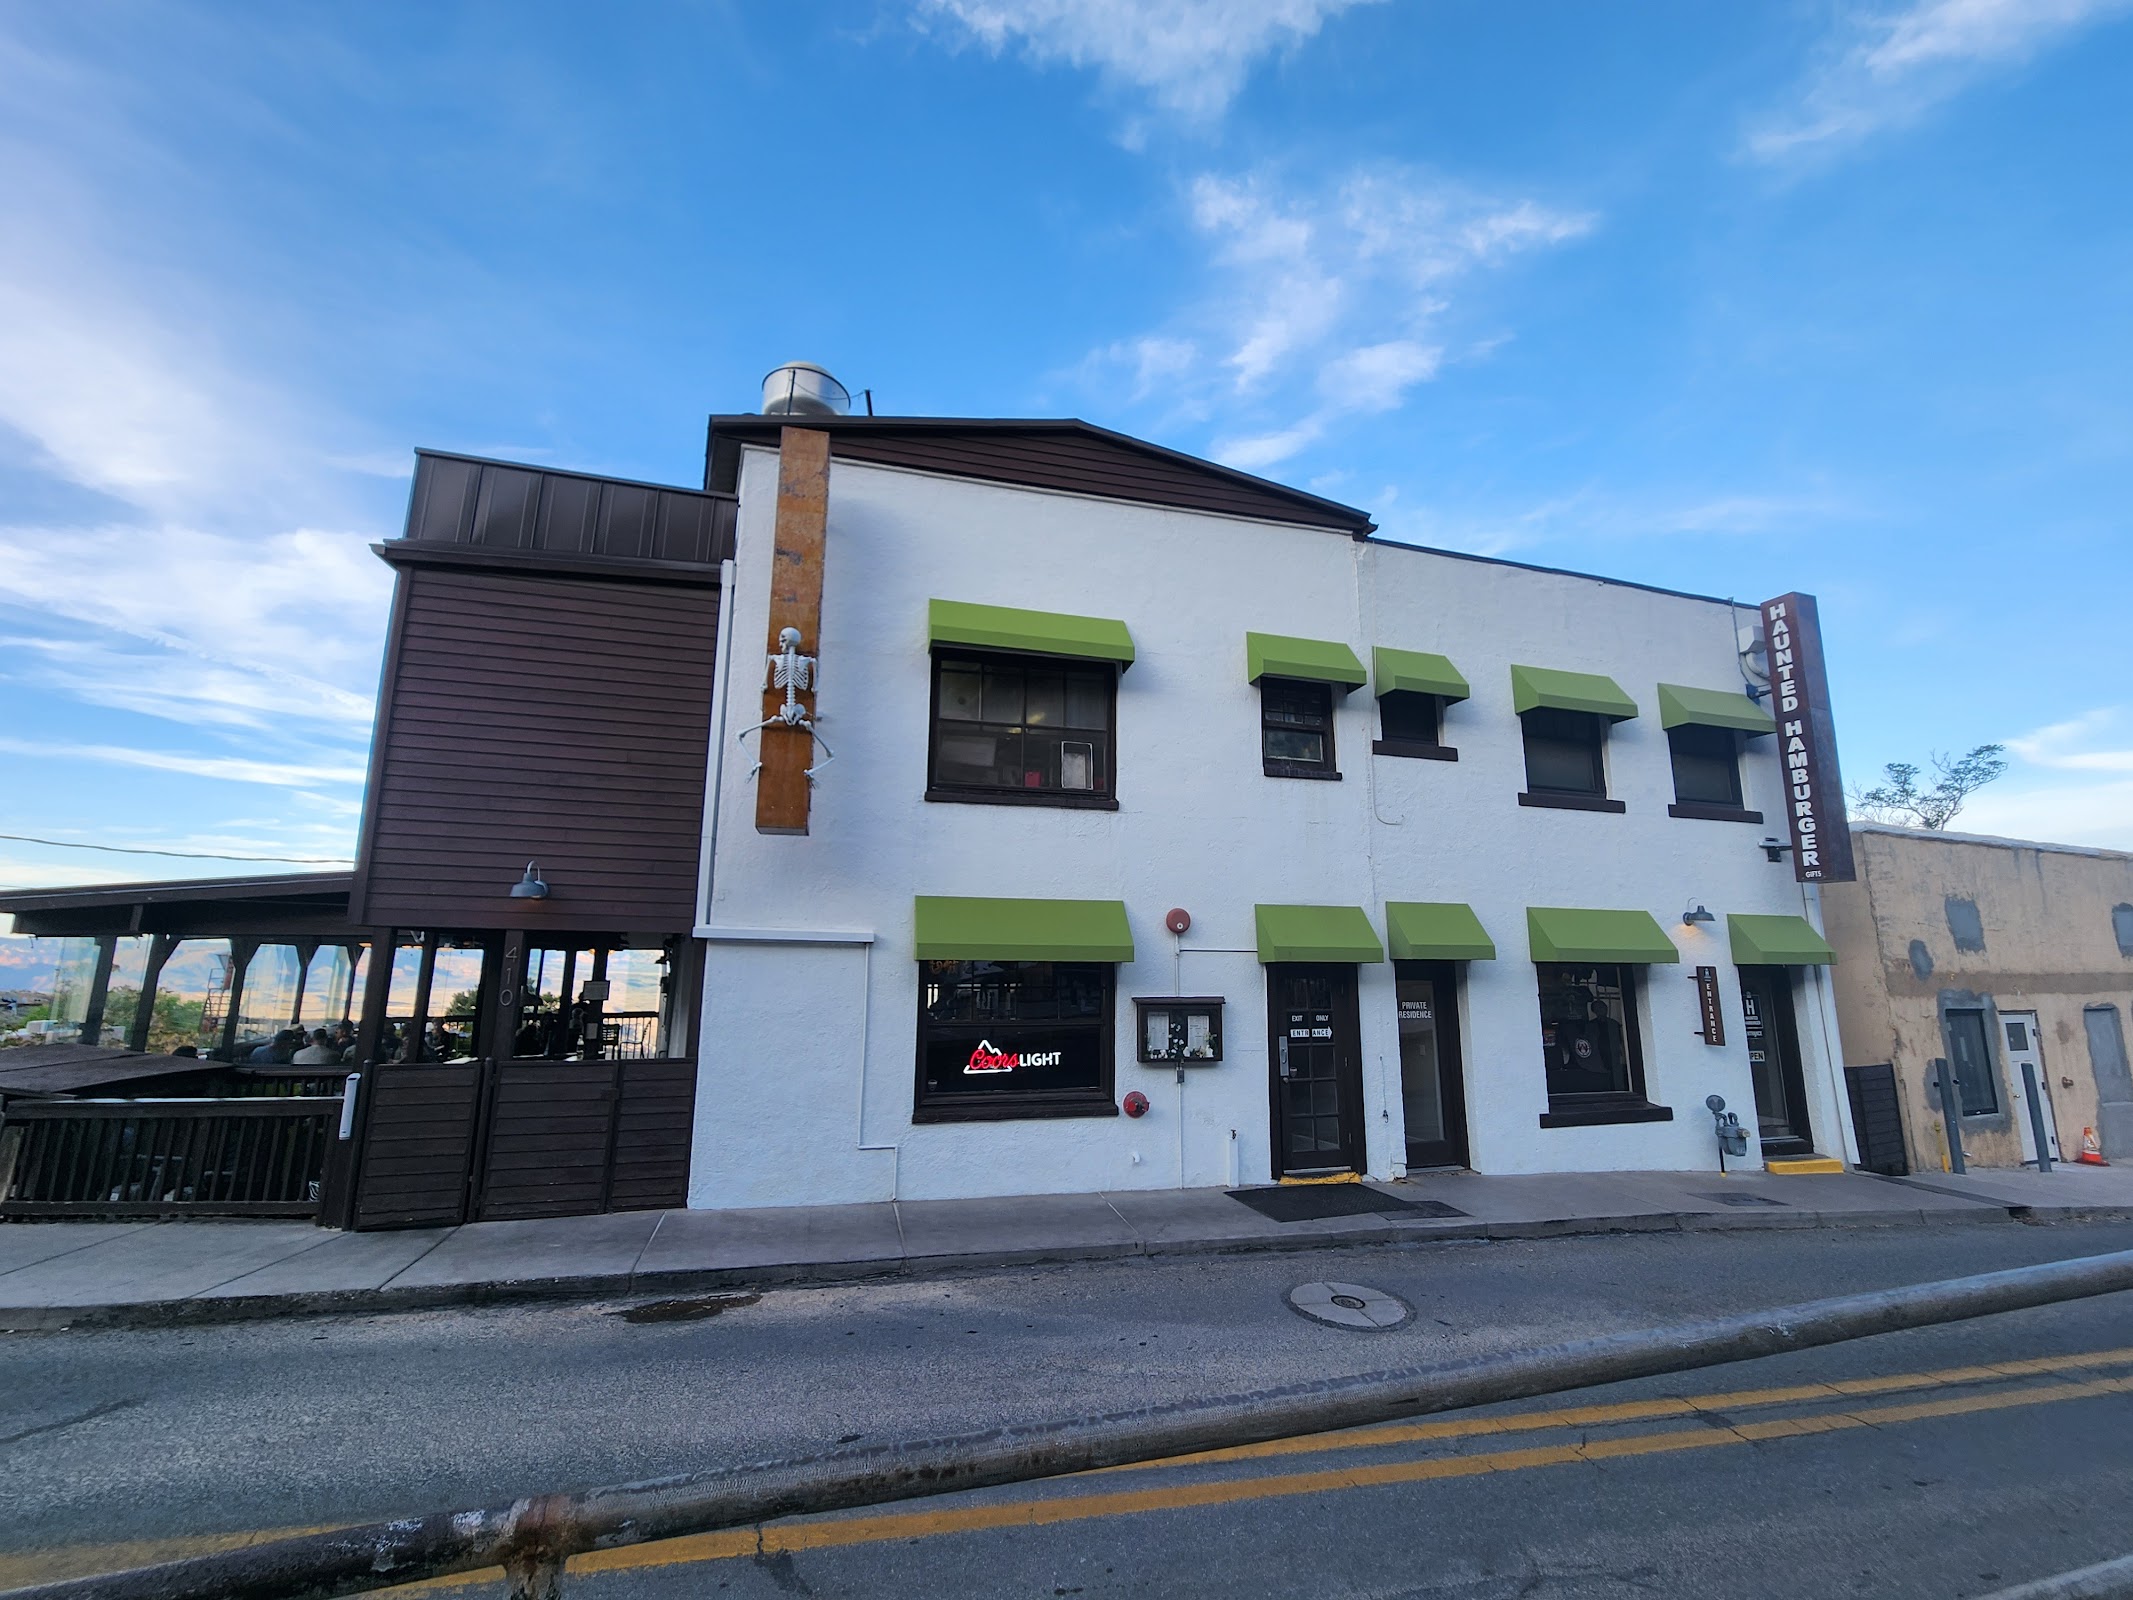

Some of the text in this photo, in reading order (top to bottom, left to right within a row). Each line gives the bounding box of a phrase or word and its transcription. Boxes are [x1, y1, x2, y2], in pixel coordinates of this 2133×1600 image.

[1769, 602, 1820, 867] HAUNTED HAMBURGER
[1805, 870, 1822, 878] GIFTS
[1401, 1001, 1428, 1010] PRIVATE
[1399, 1010, 1432, 1019] RESIDENCE
[1706, 983, 1718, 1042] ENTRANCE
[1315, 1014, 1329, 1022] ONLY
[969, 1049, 1062, 1070] Coors LIGHT
[1749, 1052, 1764, 1060] PEN
